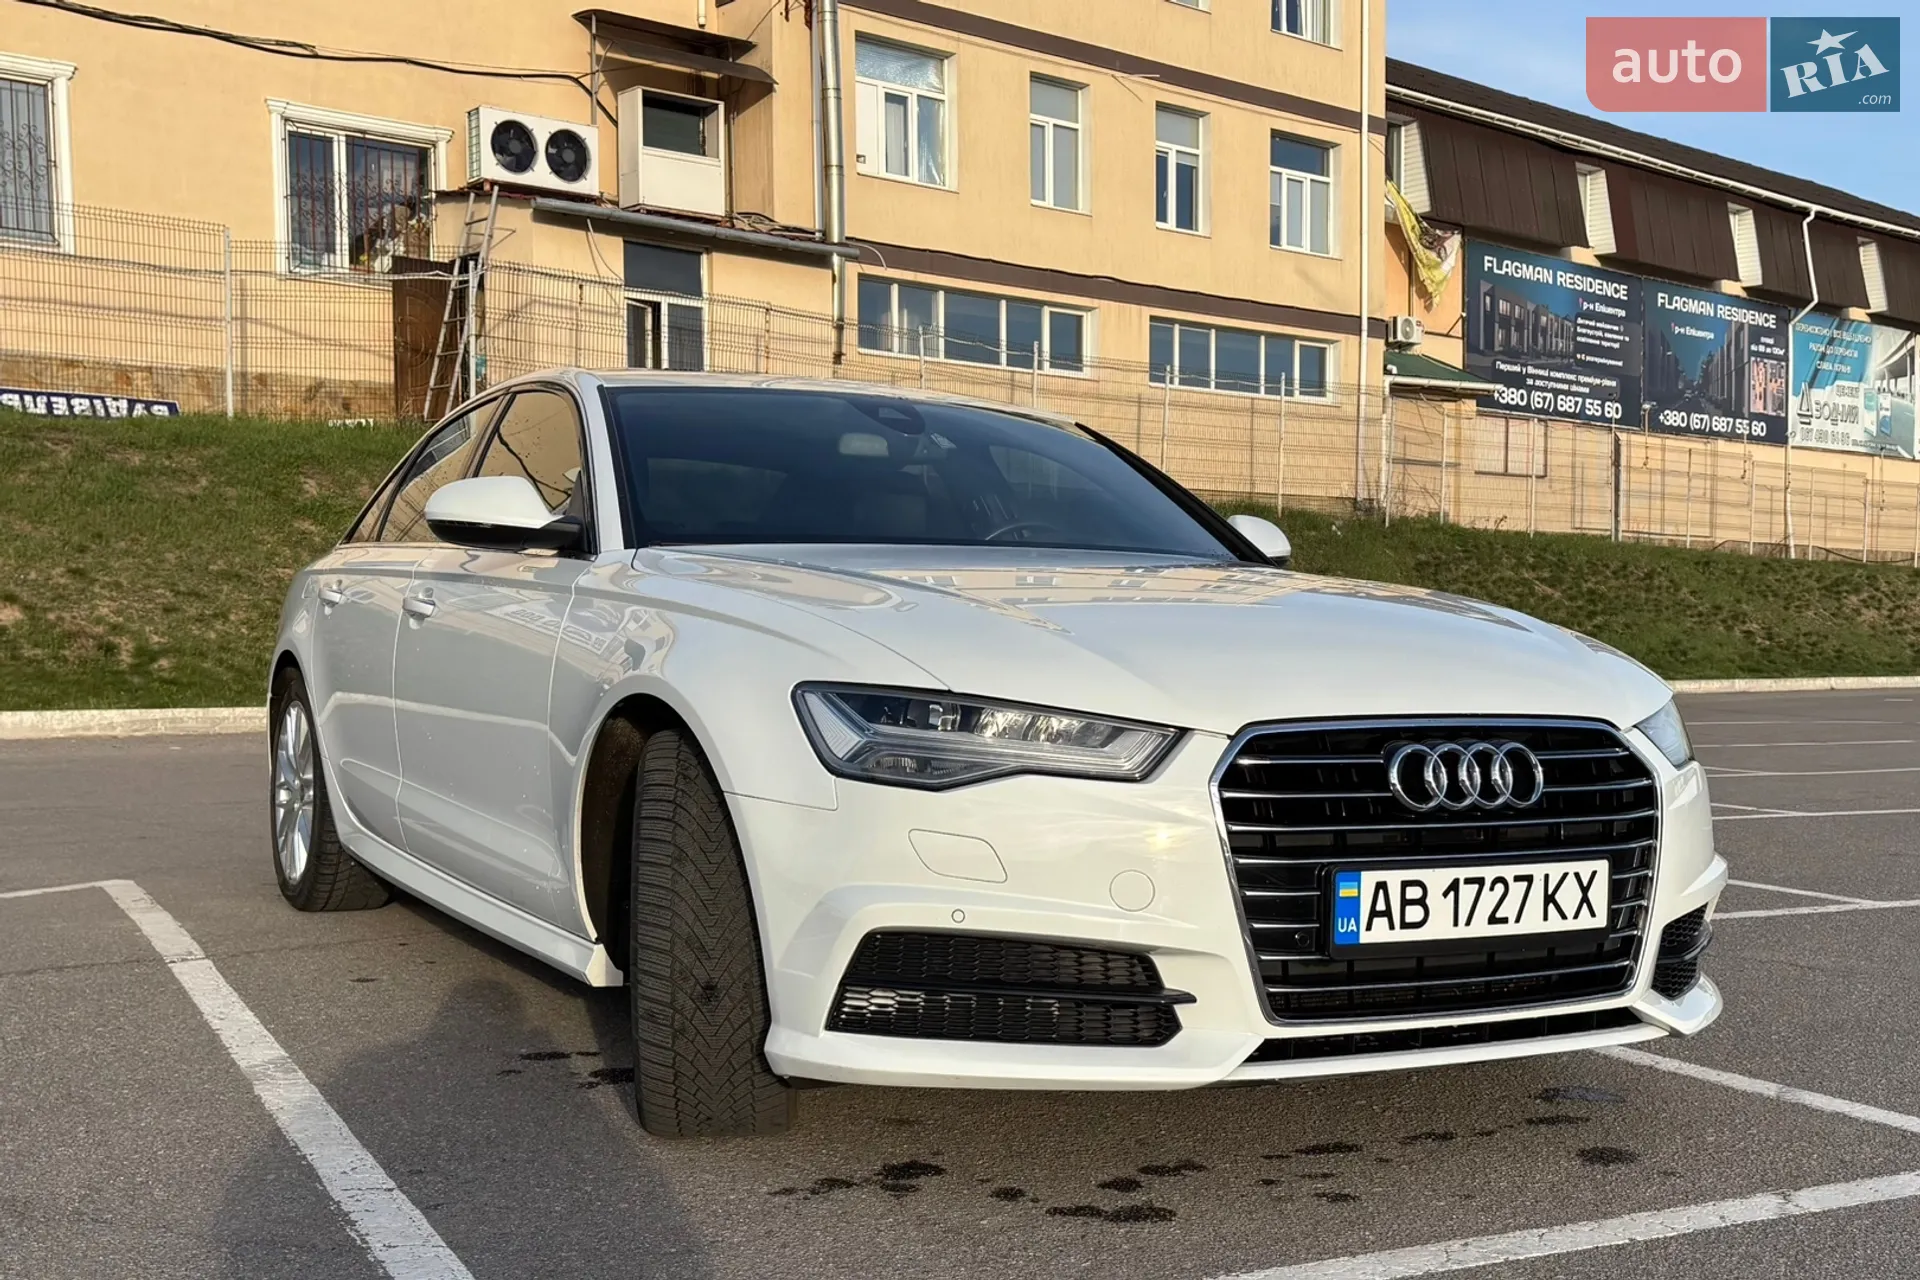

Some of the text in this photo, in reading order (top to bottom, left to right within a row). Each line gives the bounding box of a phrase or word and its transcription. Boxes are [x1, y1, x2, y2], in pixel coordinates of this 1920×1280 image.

[1484, 255, 1628, 300] FLAGMAN RESIDENCE
[1657, 292, 1777, 329] FLAGMAN RESIDENCE
[1496, 361, 1521, 373] Перший
[1494, 387, 1622, 419] +380 (67) 687 55 60
[1659, 410, 1766, 436] +380 (67) 687 55 60
[1365, 870, 1598, 931] AB 1727 KX
[1338, 917, 1357, 933] UA
